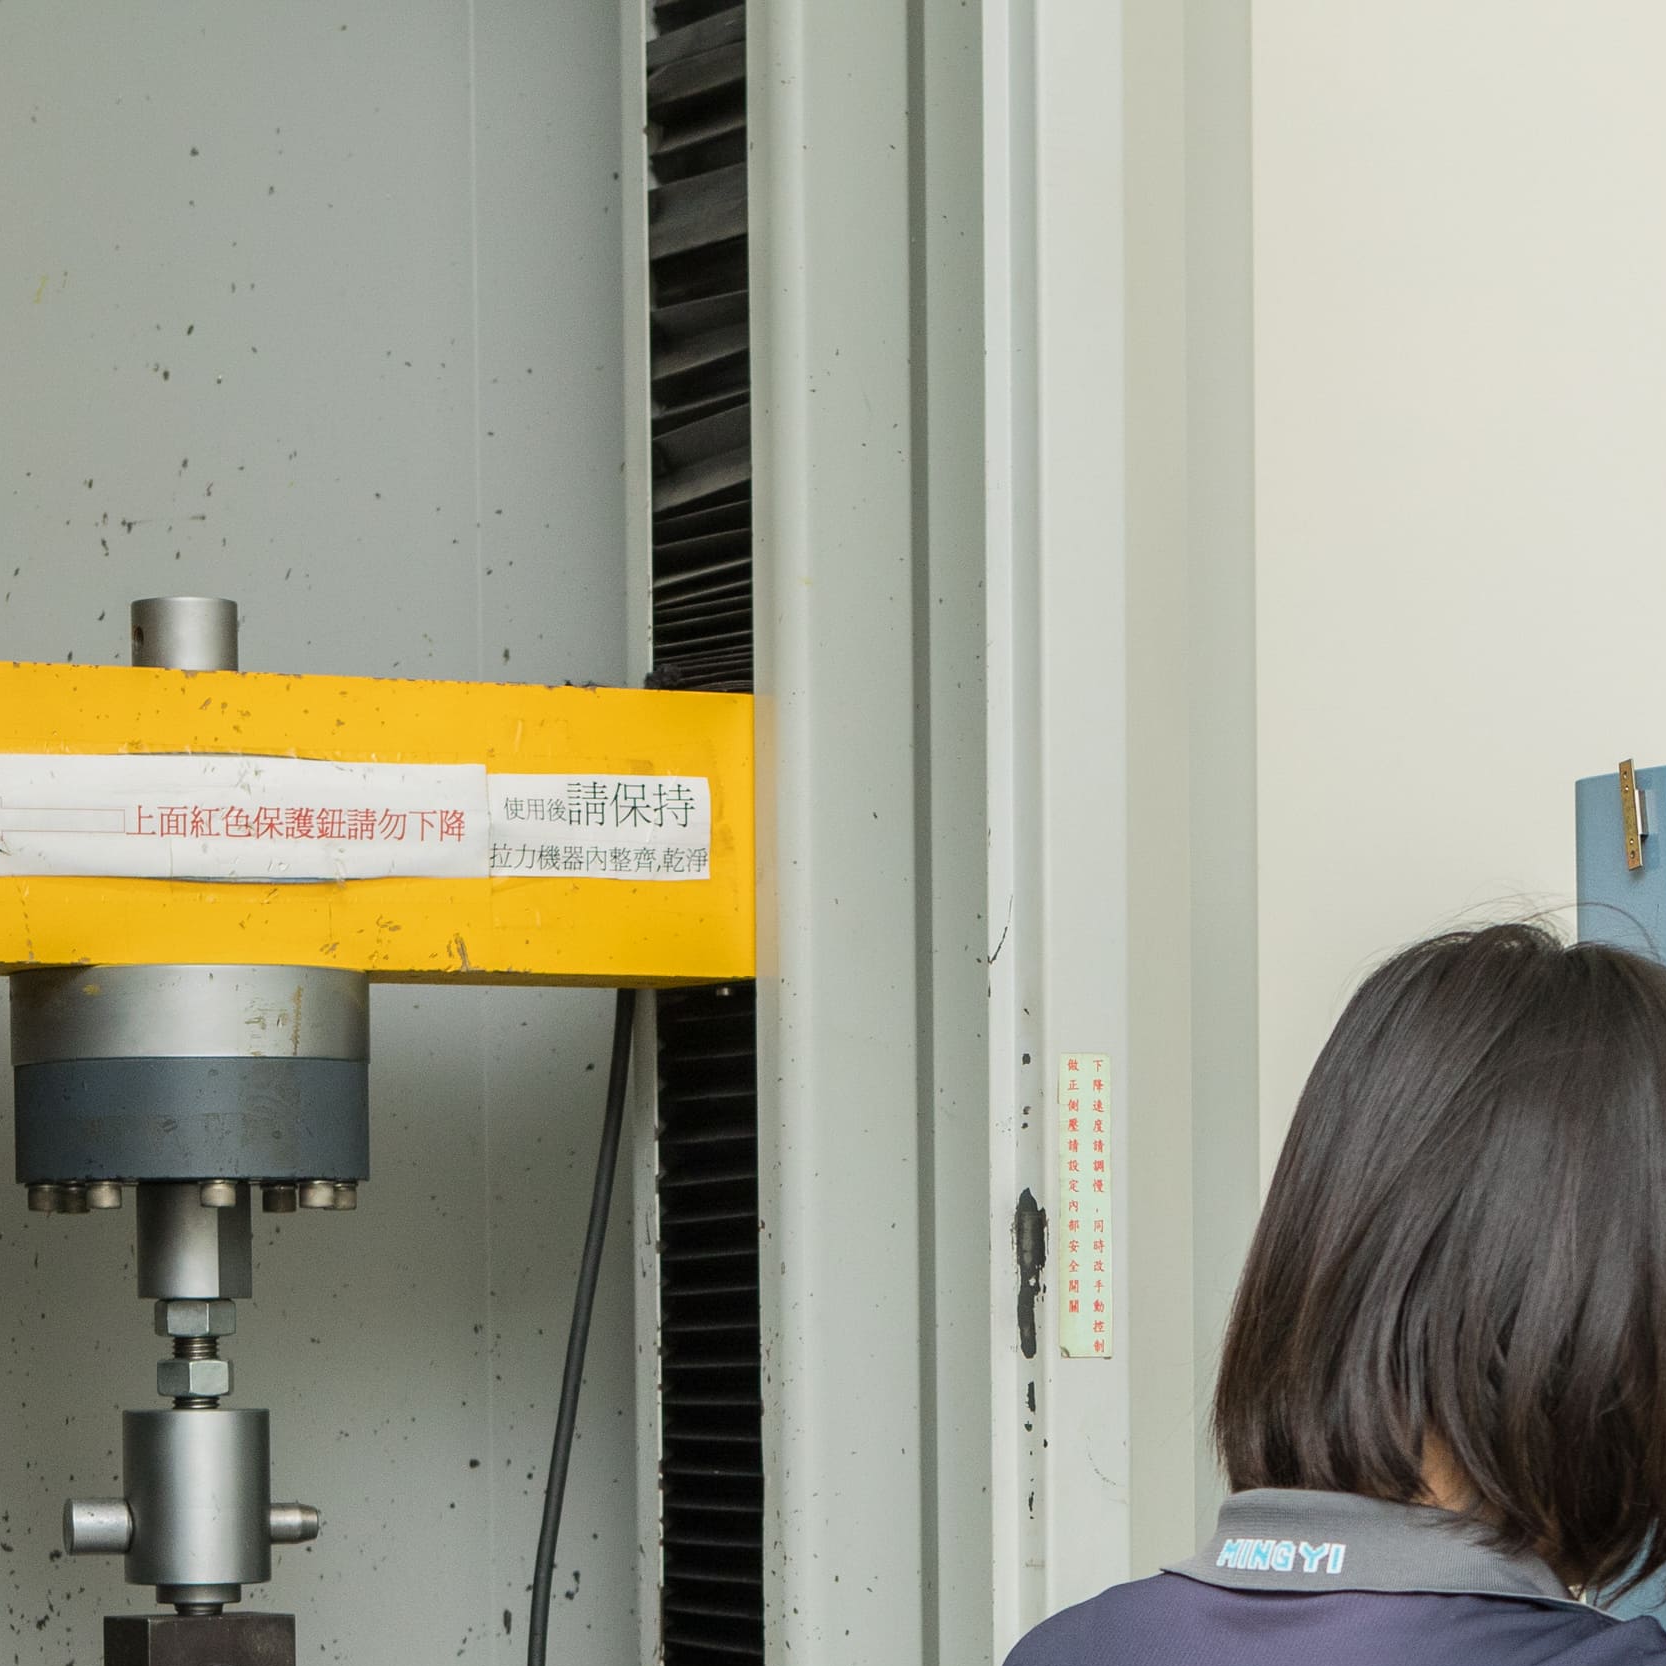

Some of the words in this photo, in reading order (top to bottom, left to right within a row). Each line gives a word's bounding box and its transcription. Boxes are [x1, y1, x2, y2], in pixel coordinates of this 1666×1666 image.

[124, 805, 466, 843] 上面紅色保護鈕請勿下降
